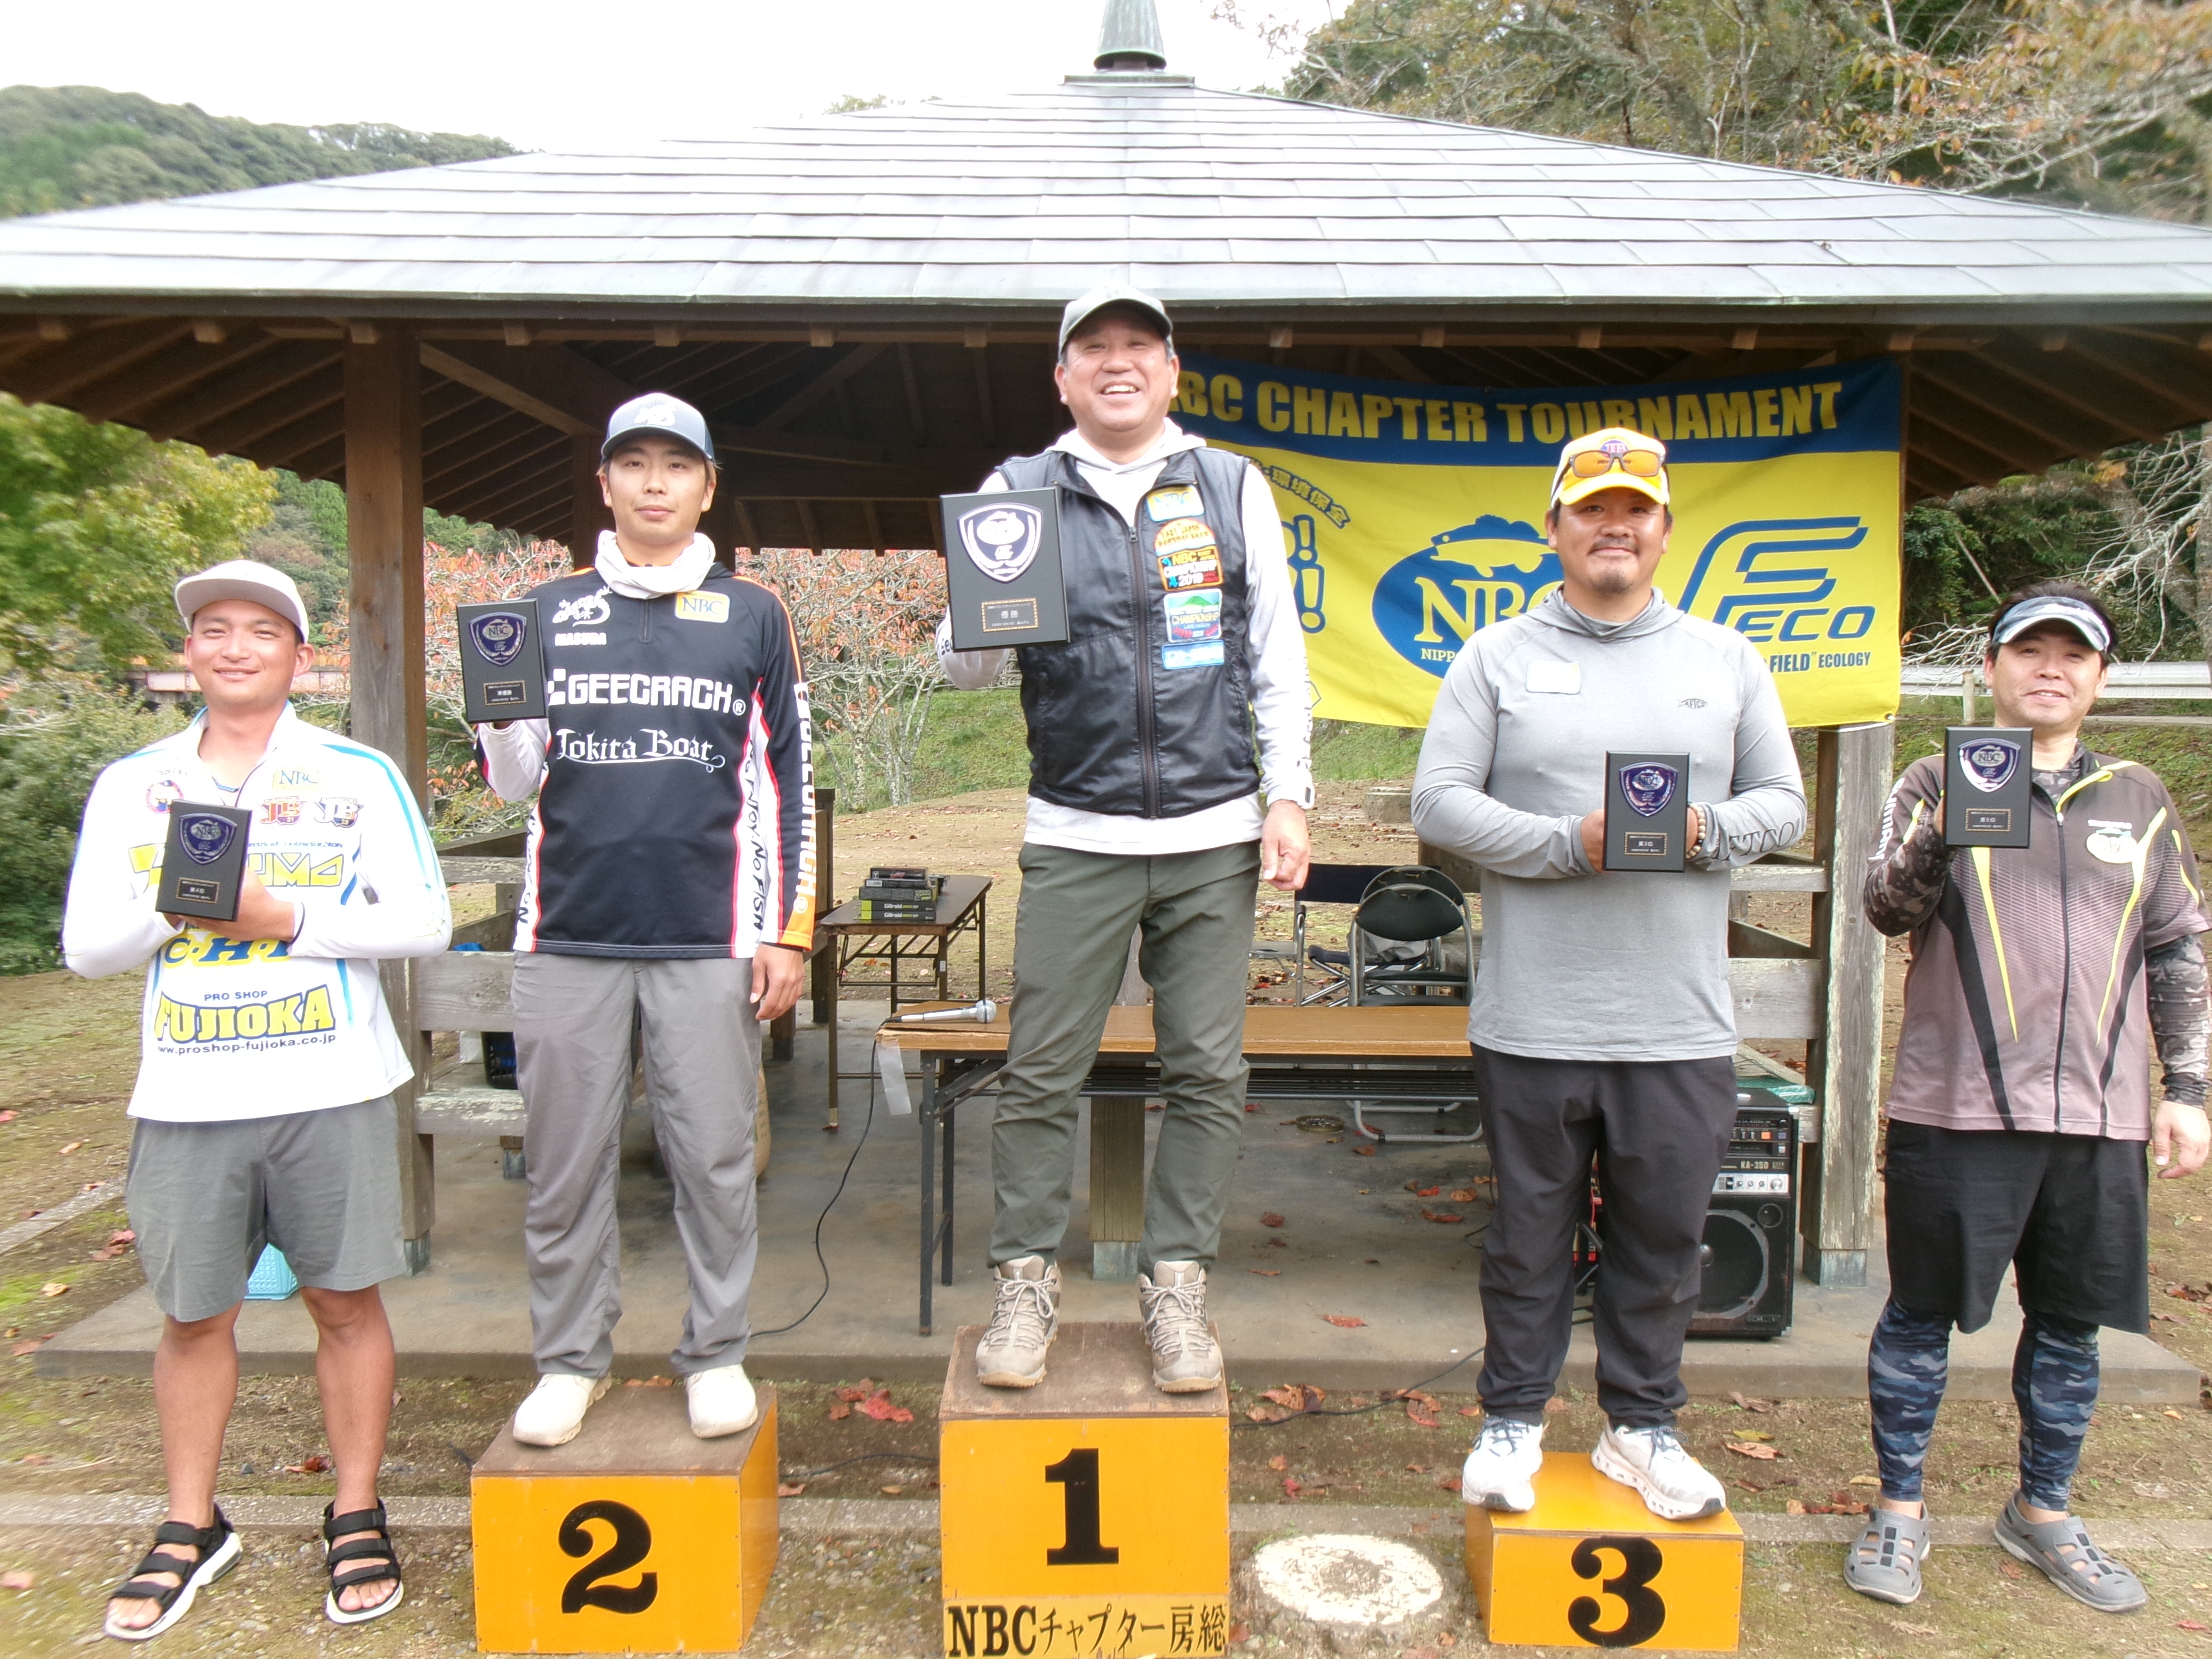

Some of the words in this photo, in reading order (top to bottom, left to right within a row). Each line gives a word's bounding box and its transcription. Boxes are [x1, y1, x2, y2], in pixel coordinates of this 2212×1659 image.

[1170, 370, 1243, 421] BC
[1257, 381, 1487, 442] CHAPTER
[1496, 382, 1841, 444] TOURNAMENT
[1171, 552, 1197, 565] NBC
[681, 597, 722, 615] NBC
[1818, 651, 1871, 668] ECOLOGY
[1977, 753, 2001, 762] NBC
[204, 993, 230, 1001] PRO
[235, 990, 268, 1000] SHOP
[154, 983, 336, 1044] FUJIOKA
[1740, 1161, 1769, 1169] KA-350
[1045, 1448, 1119, 1566] 1
[558, 1499, 658, 1614] 2
[1567, 1536, 1666, 1648] 3
